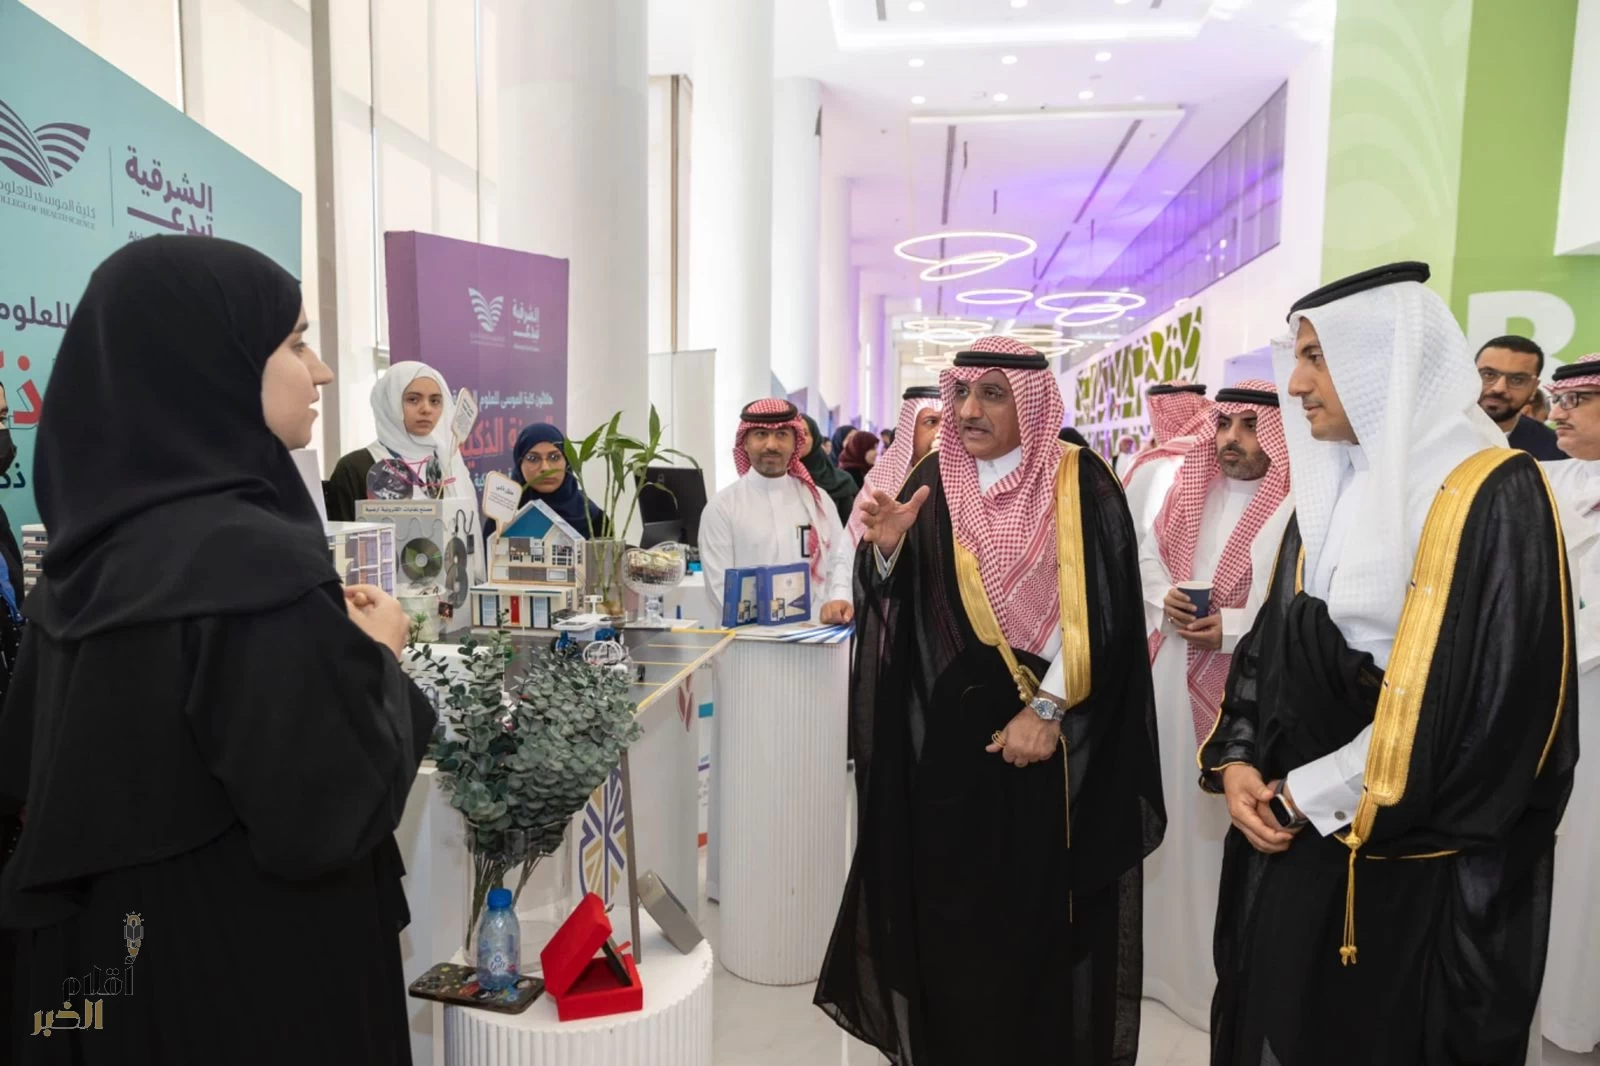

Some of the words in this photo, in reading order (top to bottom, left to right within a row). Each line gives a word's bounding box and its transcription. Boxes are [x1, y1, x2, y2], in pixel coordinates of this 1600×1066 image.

[0, 180, 33, 199] للعلو
[125, 145, 213, 213] الشرقية
[459, 415, 504, 469] الذكي
